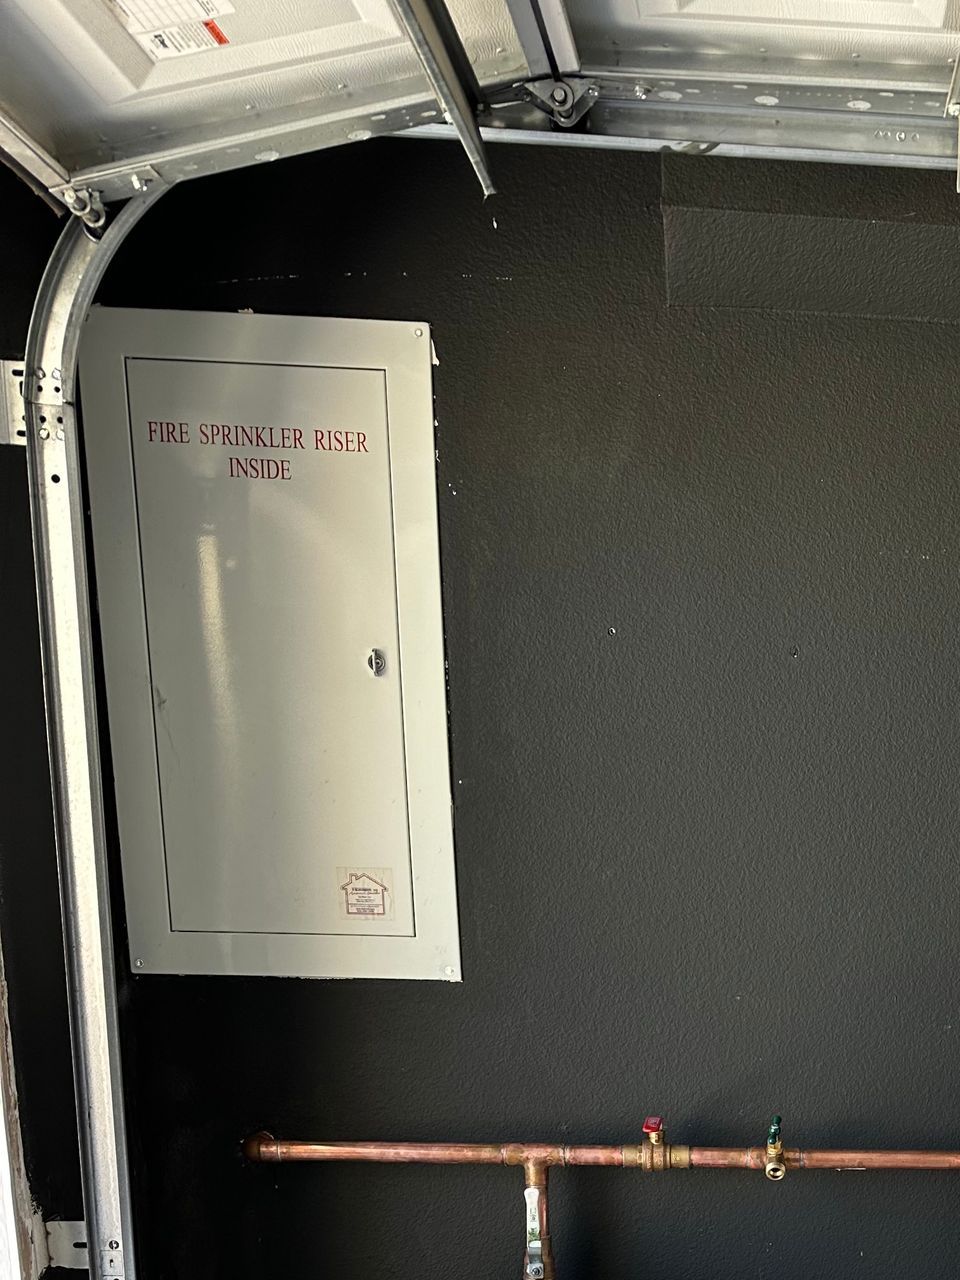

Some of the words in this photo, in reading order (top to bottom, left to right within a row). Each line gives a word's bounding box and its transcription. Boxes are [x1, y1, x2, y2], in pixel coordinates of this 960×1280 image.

[147, 421, 191, 444] FIRE
[199, 423, 306, 450] SPRINKLER
[313, 429, 369, 453] RISER
[228, 457, 292, 480] INSIDE
